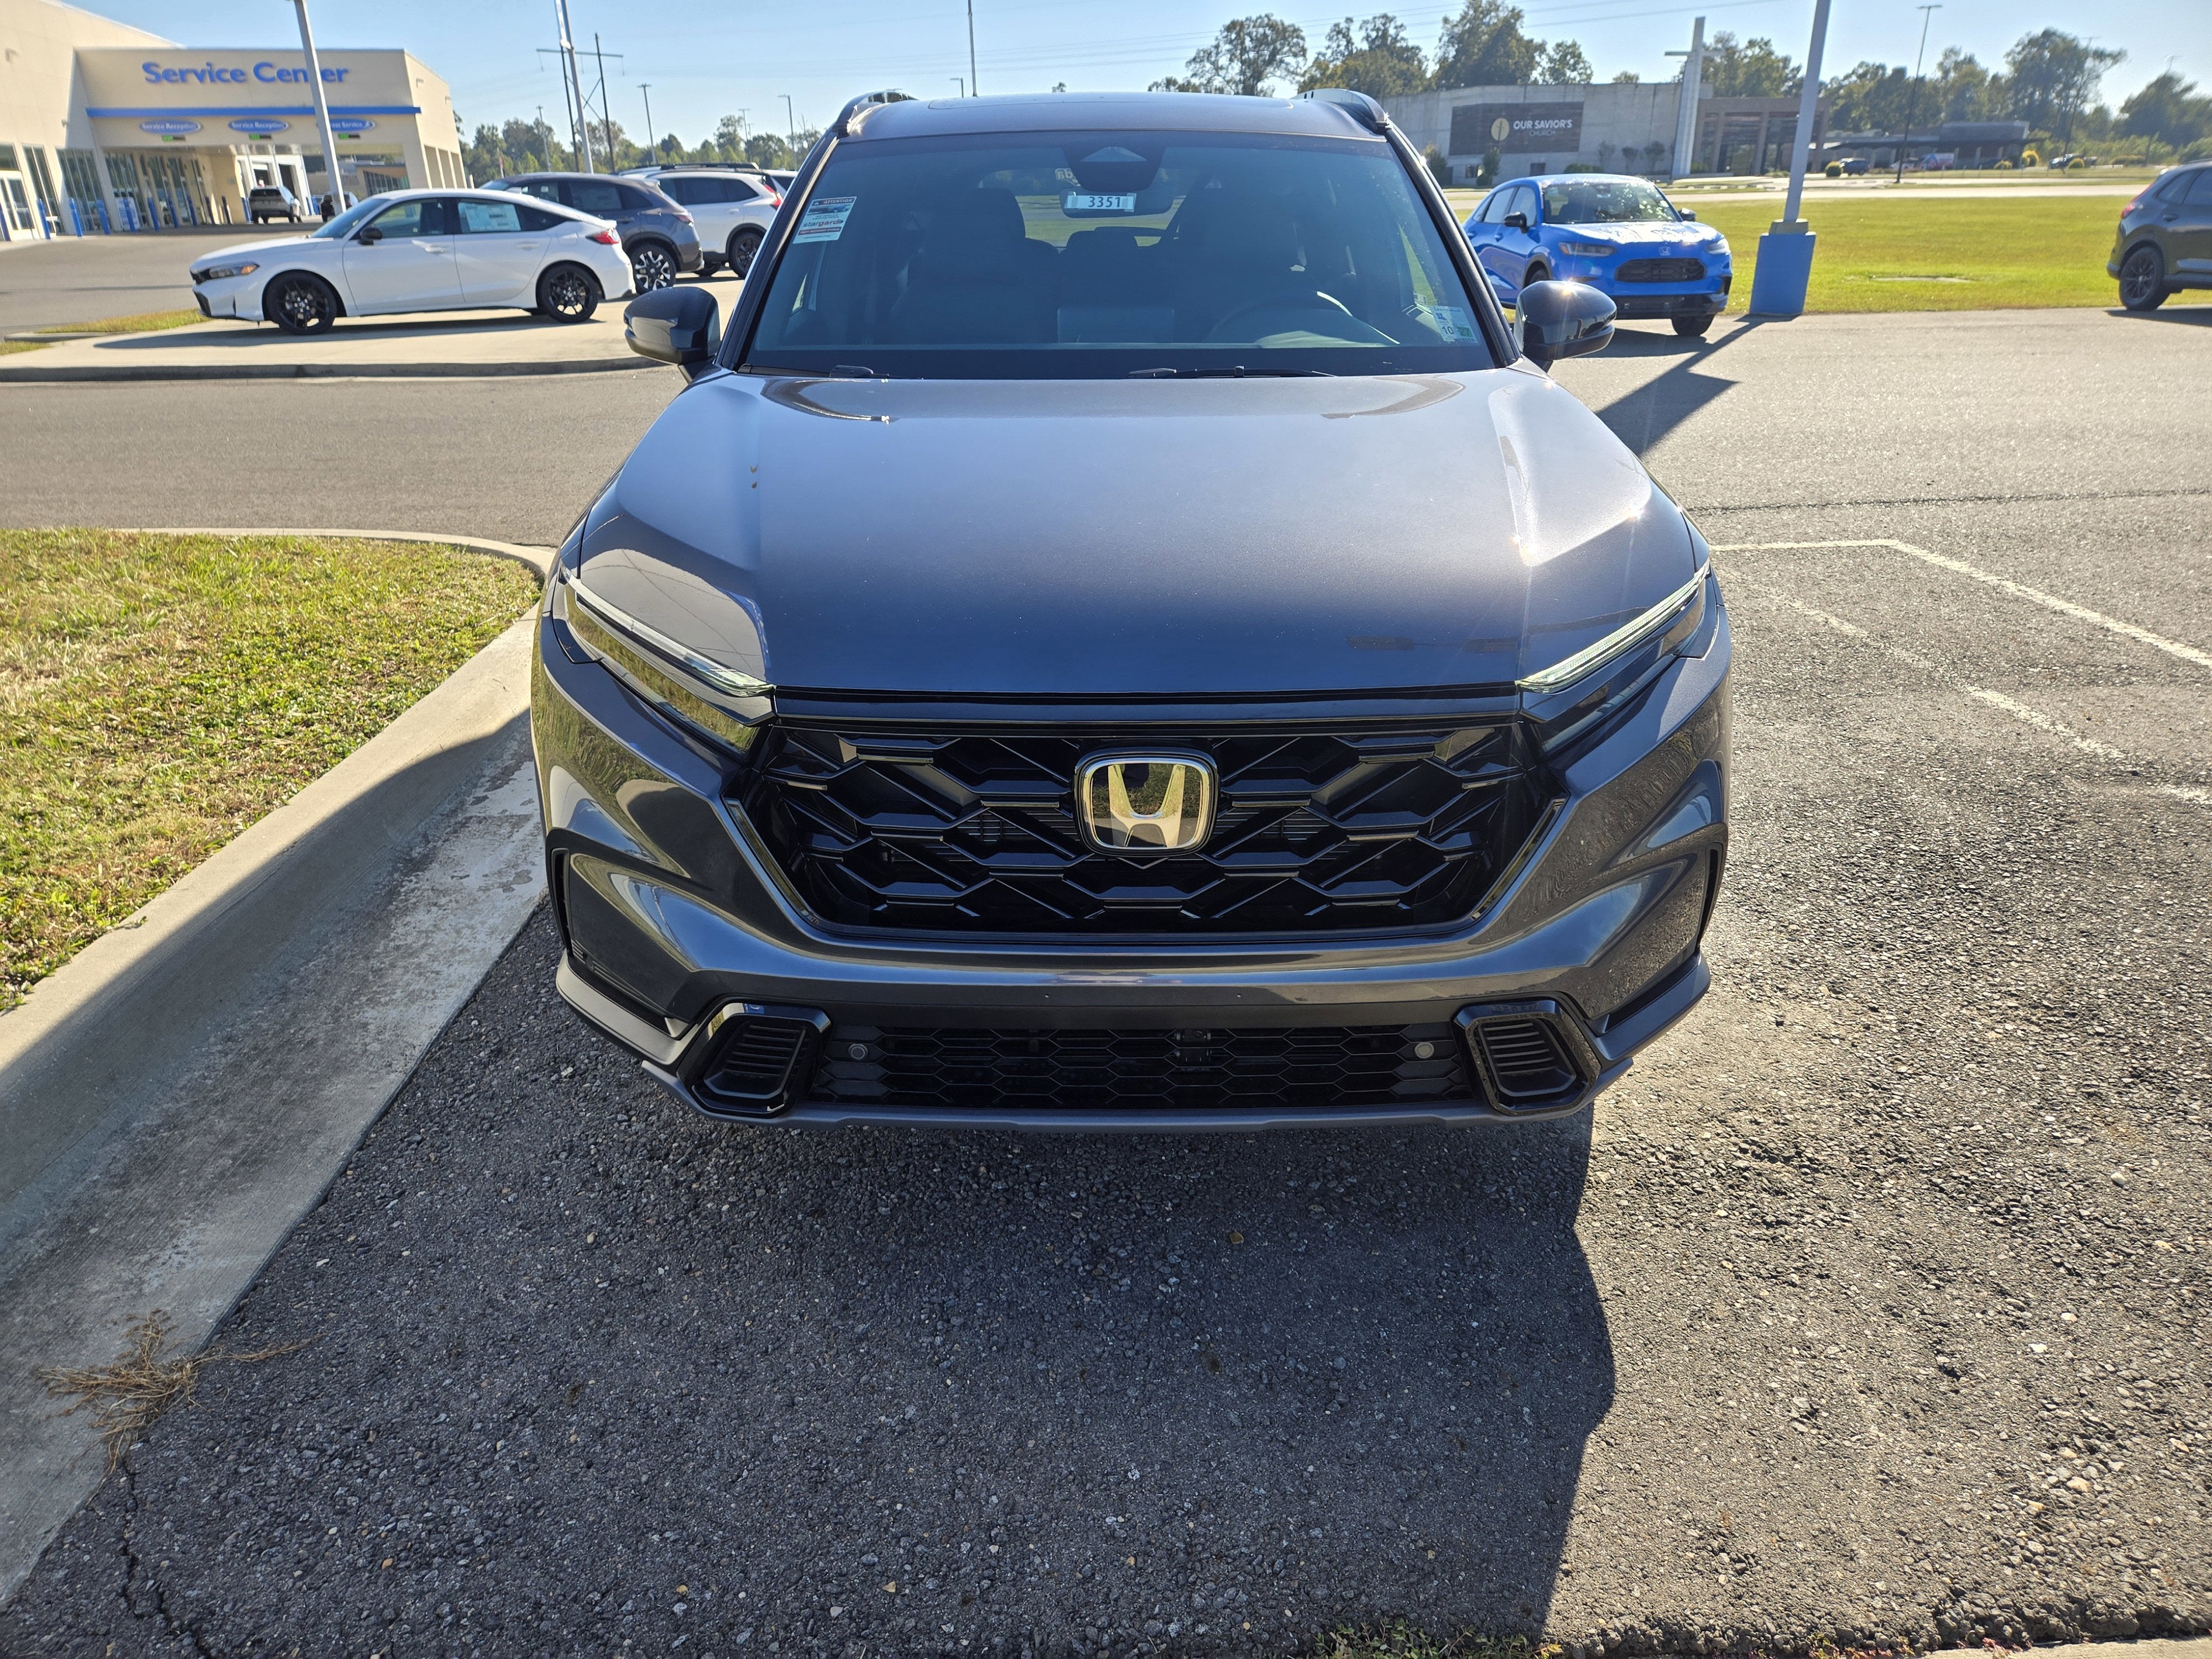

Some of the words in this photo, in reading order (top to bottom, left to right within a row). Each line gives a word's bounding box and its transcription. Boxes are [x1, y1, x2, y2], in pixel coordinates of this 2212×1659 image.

[142, 61, 247, 83] Service
[253, 61, 349, 83] Cener
[1513, 121, 1533, 129] OUR
[1534, 119, 1573, 129] SAVIOR'S
[1088, 196, 1120, 208] 3351
[1442, 326, 1454, 335] 10
